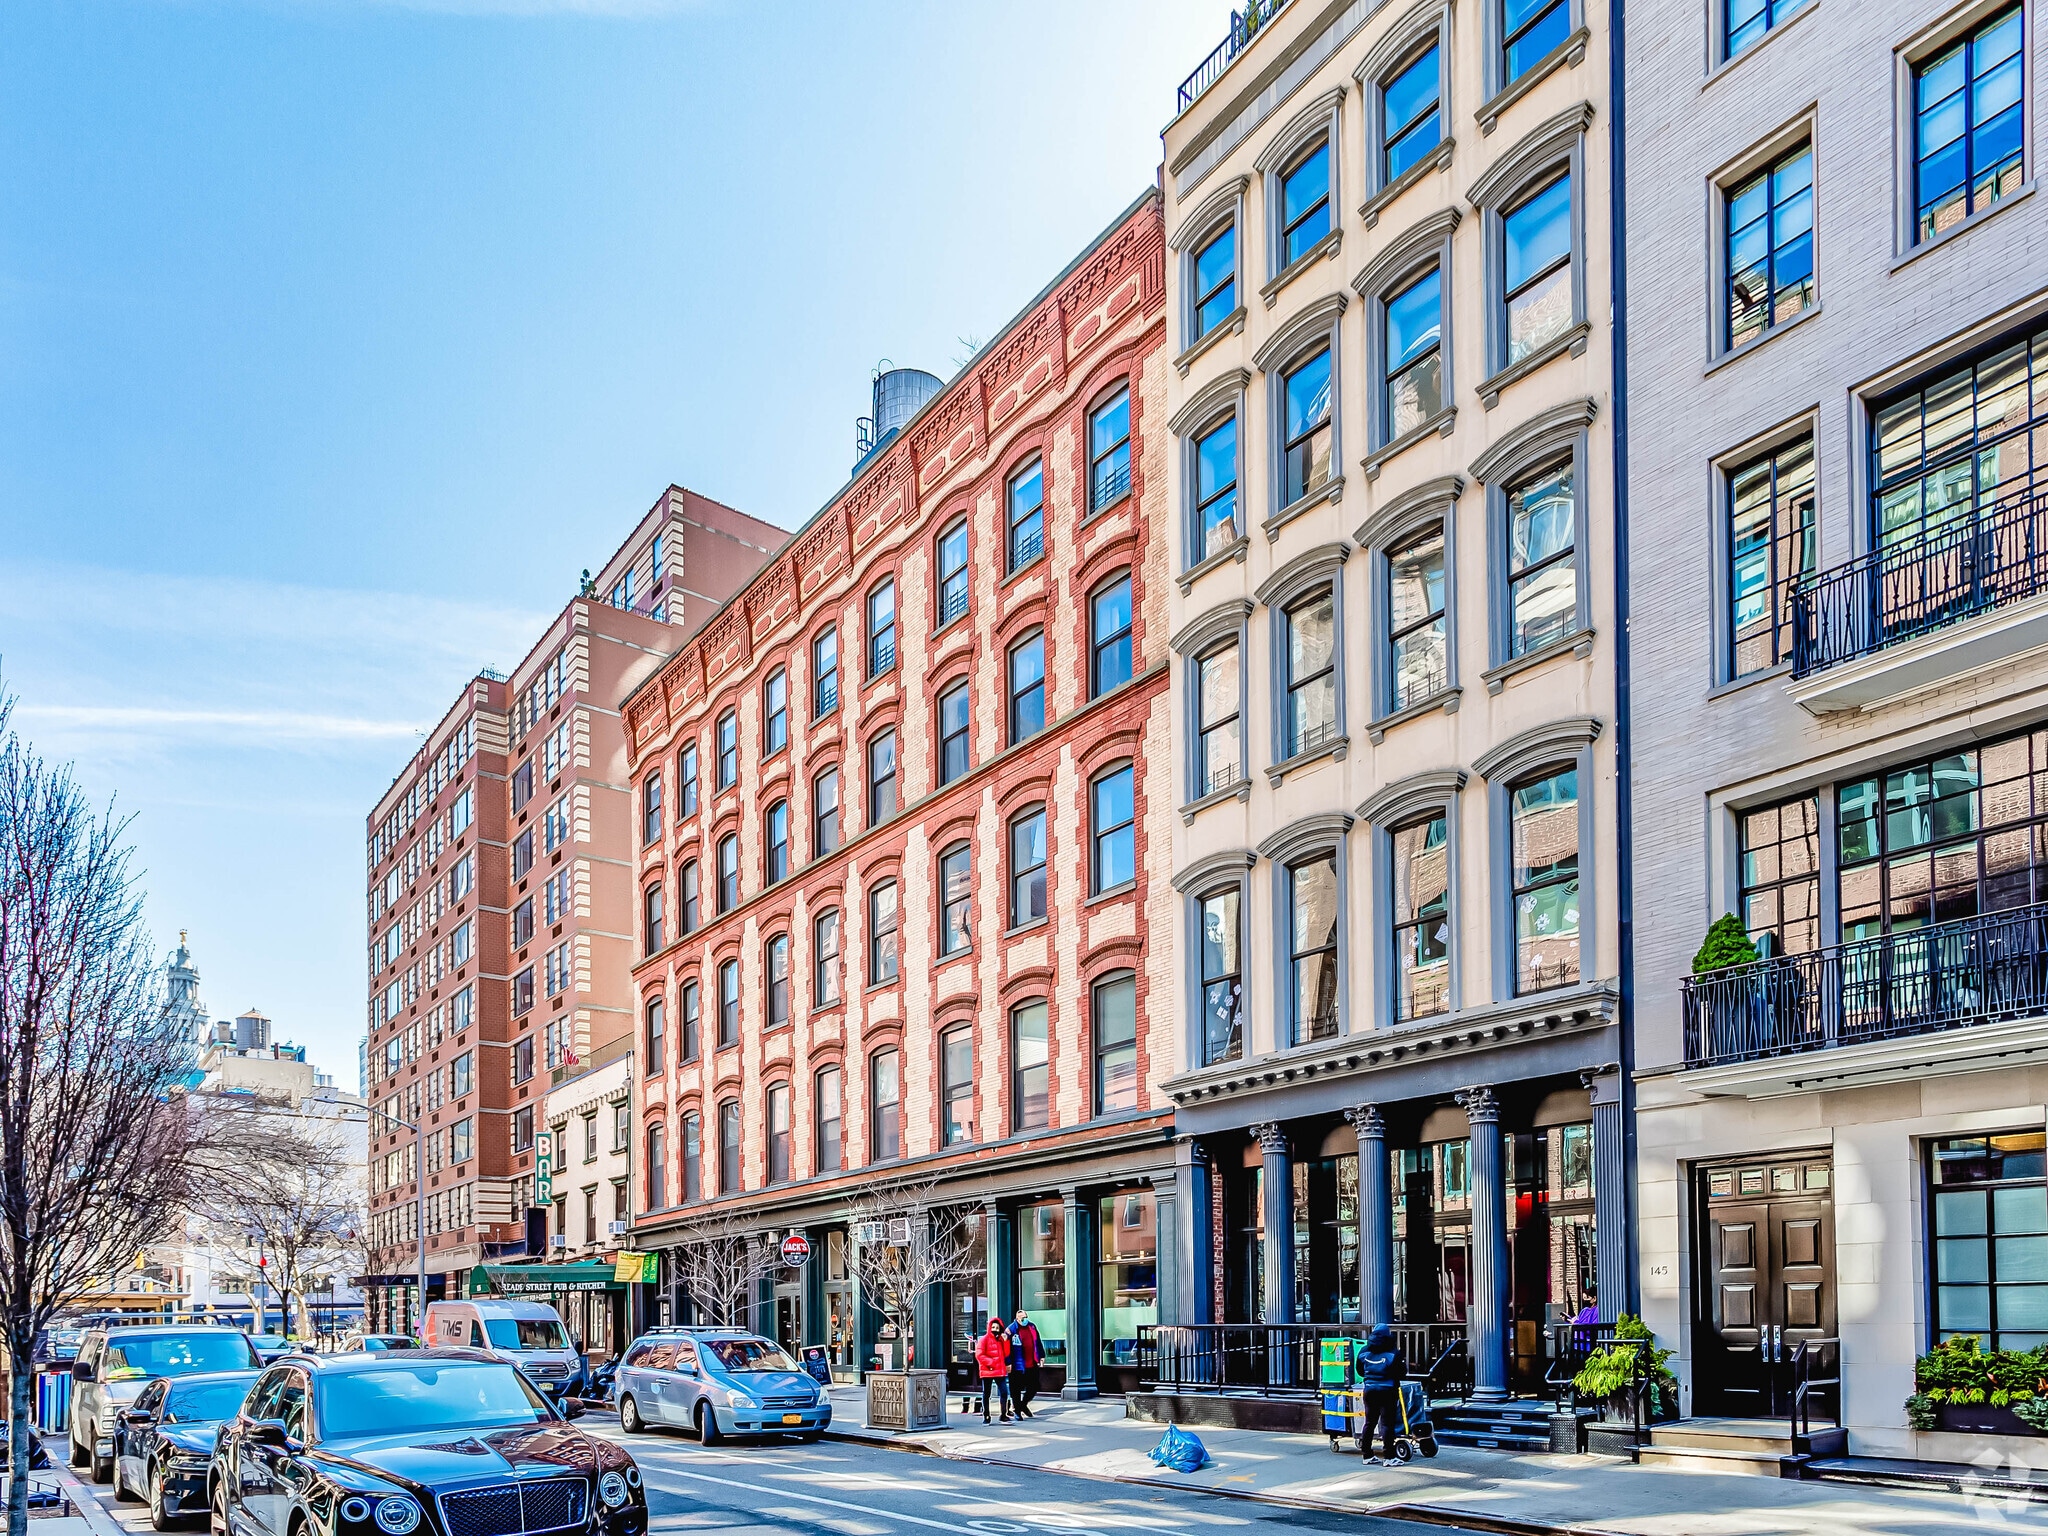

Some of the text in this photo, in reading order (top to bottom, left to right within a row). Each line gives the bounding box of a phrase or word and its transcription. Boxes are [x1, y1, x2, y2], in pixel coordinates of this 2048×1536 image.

[538, 1136, 551, 1201] BAR
[784, 1243, 808, 1251] JACK'S
[1650, 1265, 1668, 1276] 145
[525, 1282, 552, 1291] STREET
[553, 1282, 567, 1290] PUB
[568, 1282, 577, 1290] &
[577, 1281, 606, 1290] KITCHEN
[442, 1319, 463, 1337] TMS
